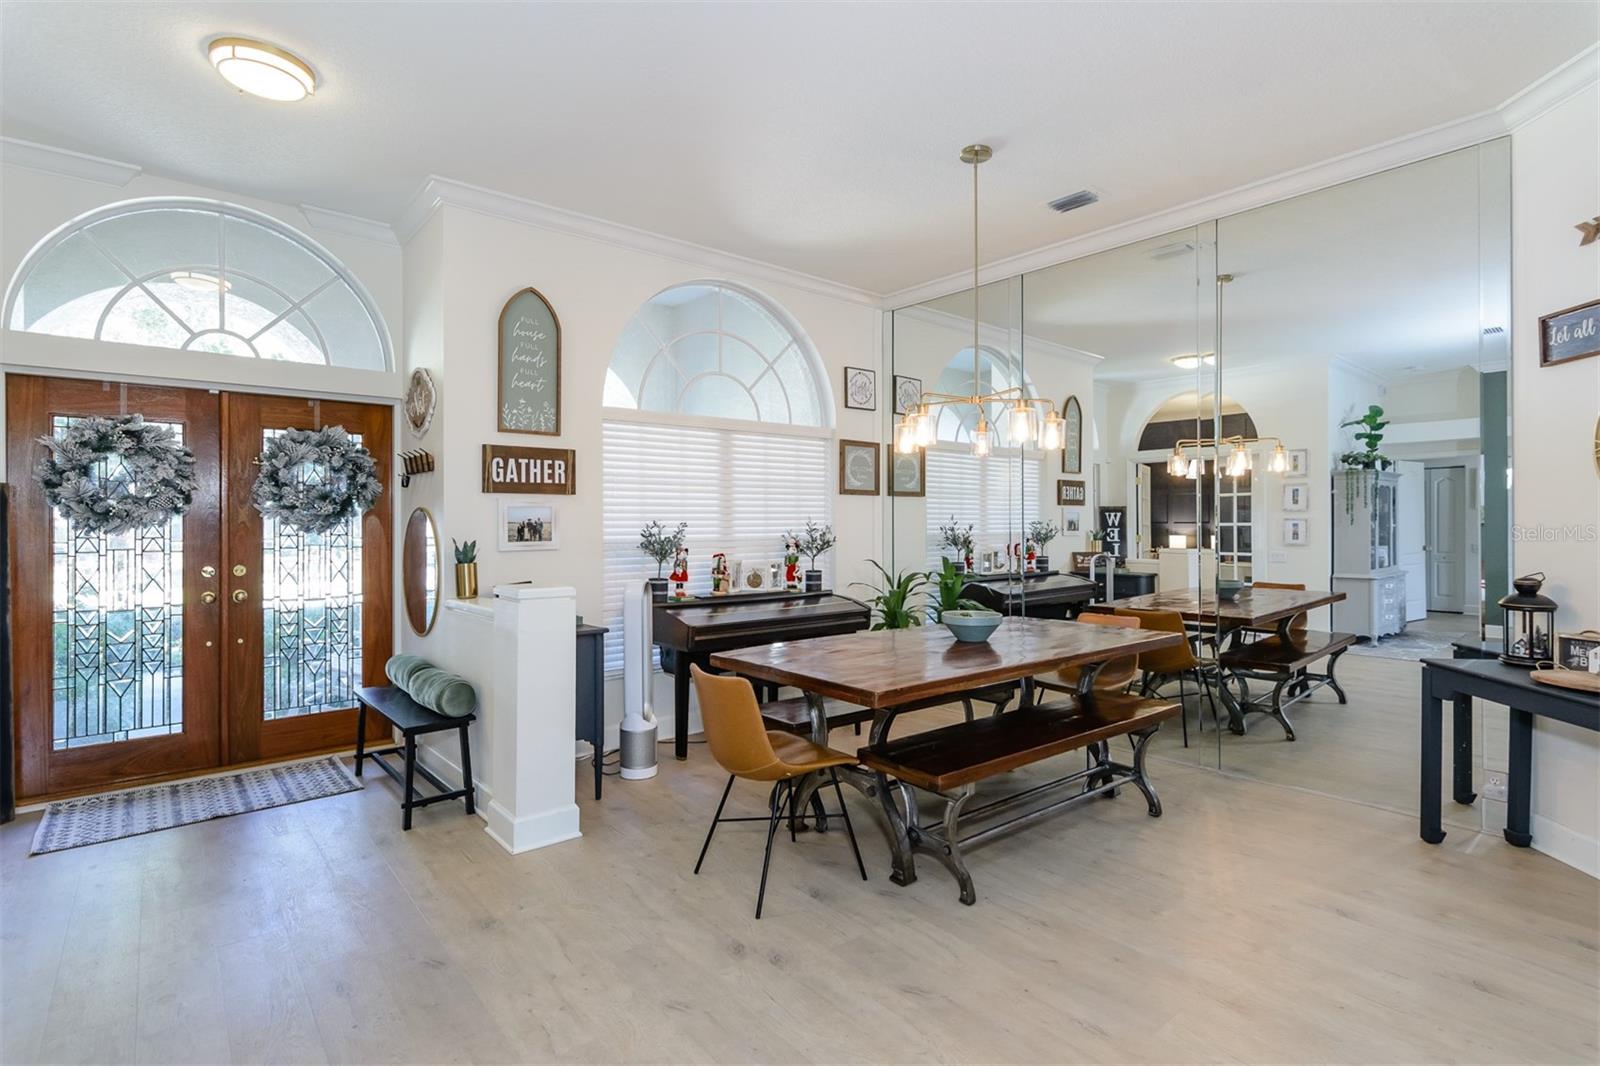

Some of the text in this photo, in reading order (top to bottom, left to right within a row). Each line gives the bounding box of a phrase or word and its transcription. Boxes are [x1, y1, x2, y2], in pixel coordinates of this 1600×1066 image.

[512, 320, 546, 341] house
[1549, 317, 1597, 346] Let all
[511, 346, 548, 368] hands
[511, 372, 546, 392] heart
[491, 457, 566, 484] GATHER
